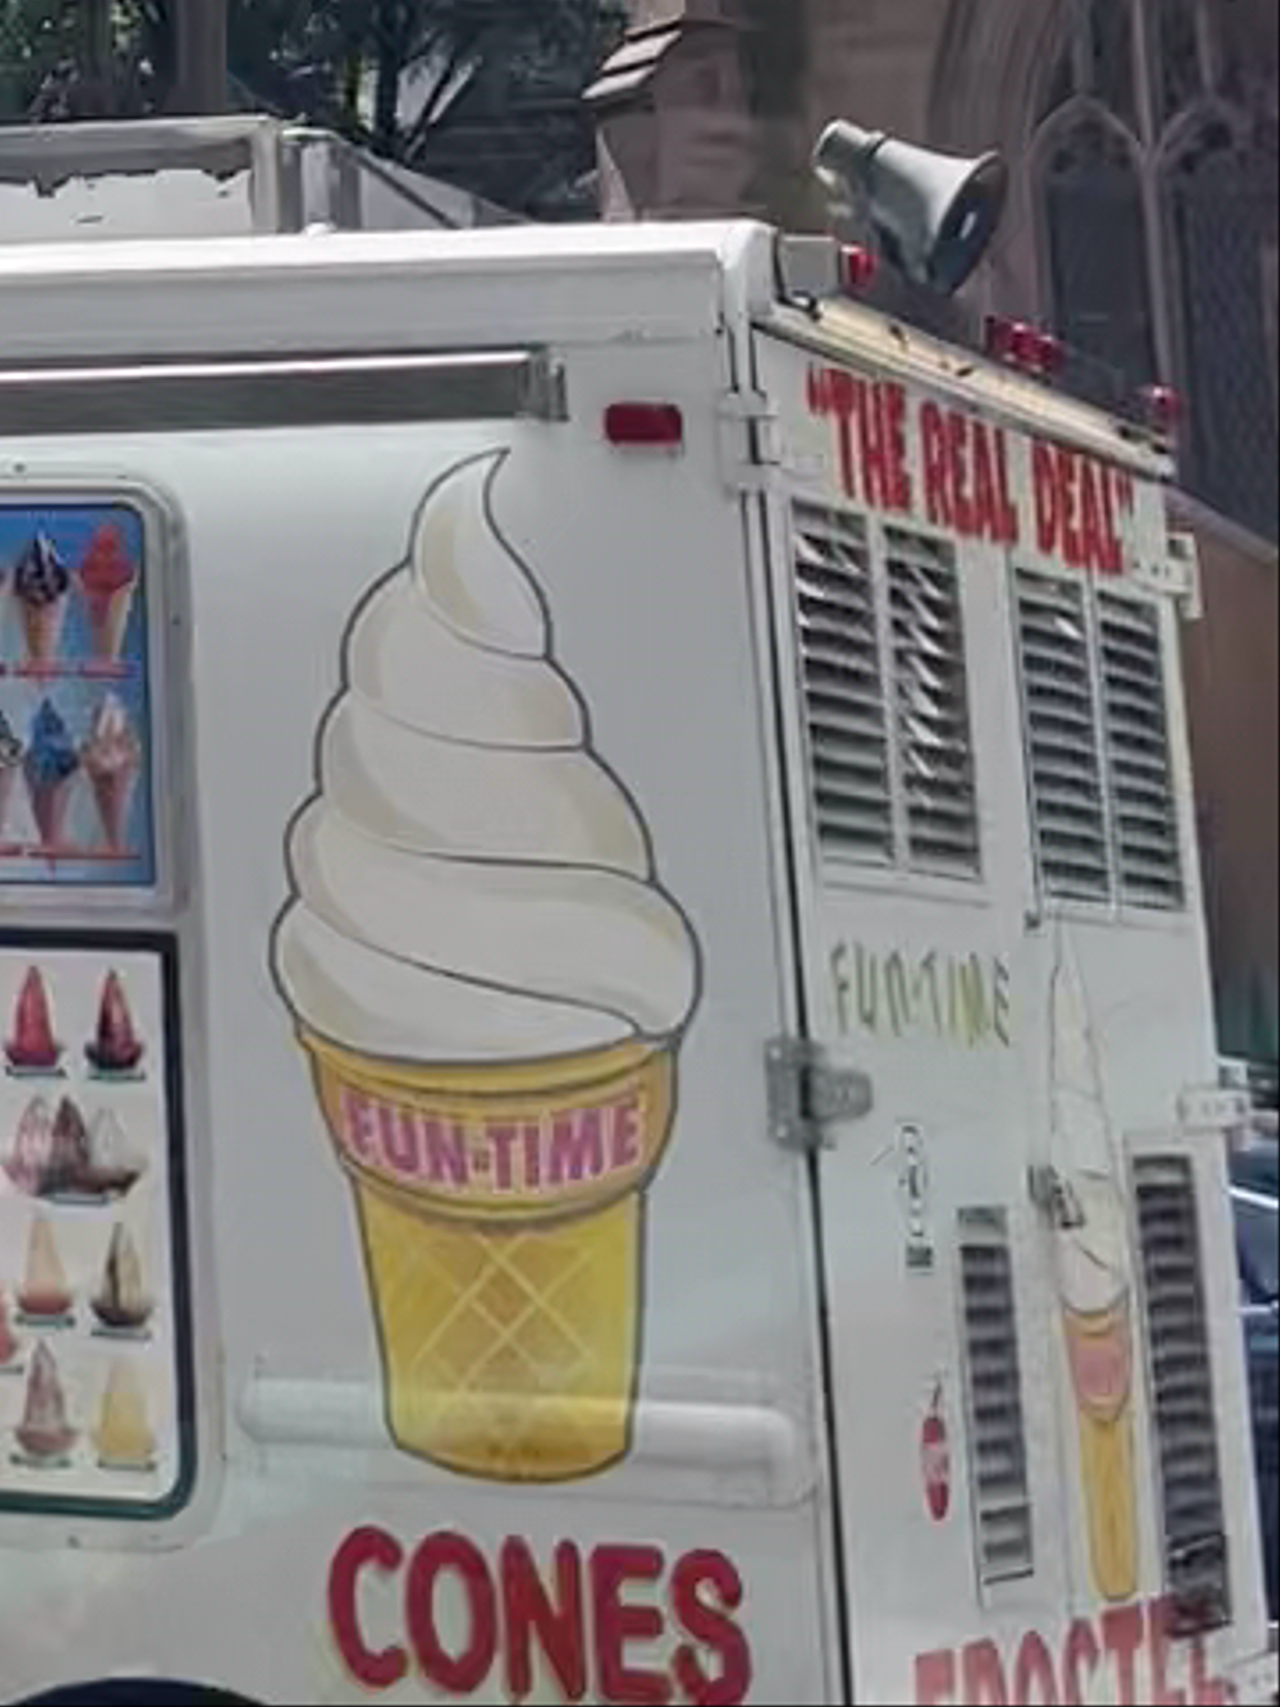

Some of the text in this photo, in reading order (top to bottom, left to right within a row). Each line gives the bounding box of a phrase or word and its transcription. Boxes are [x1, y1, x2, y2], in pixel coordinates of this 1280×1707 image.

[919, 399, 1019, 546] REAL
[342, 1086, 642, 1192] FUN-TIME
[328, 1525, 753, 1706] CONES
